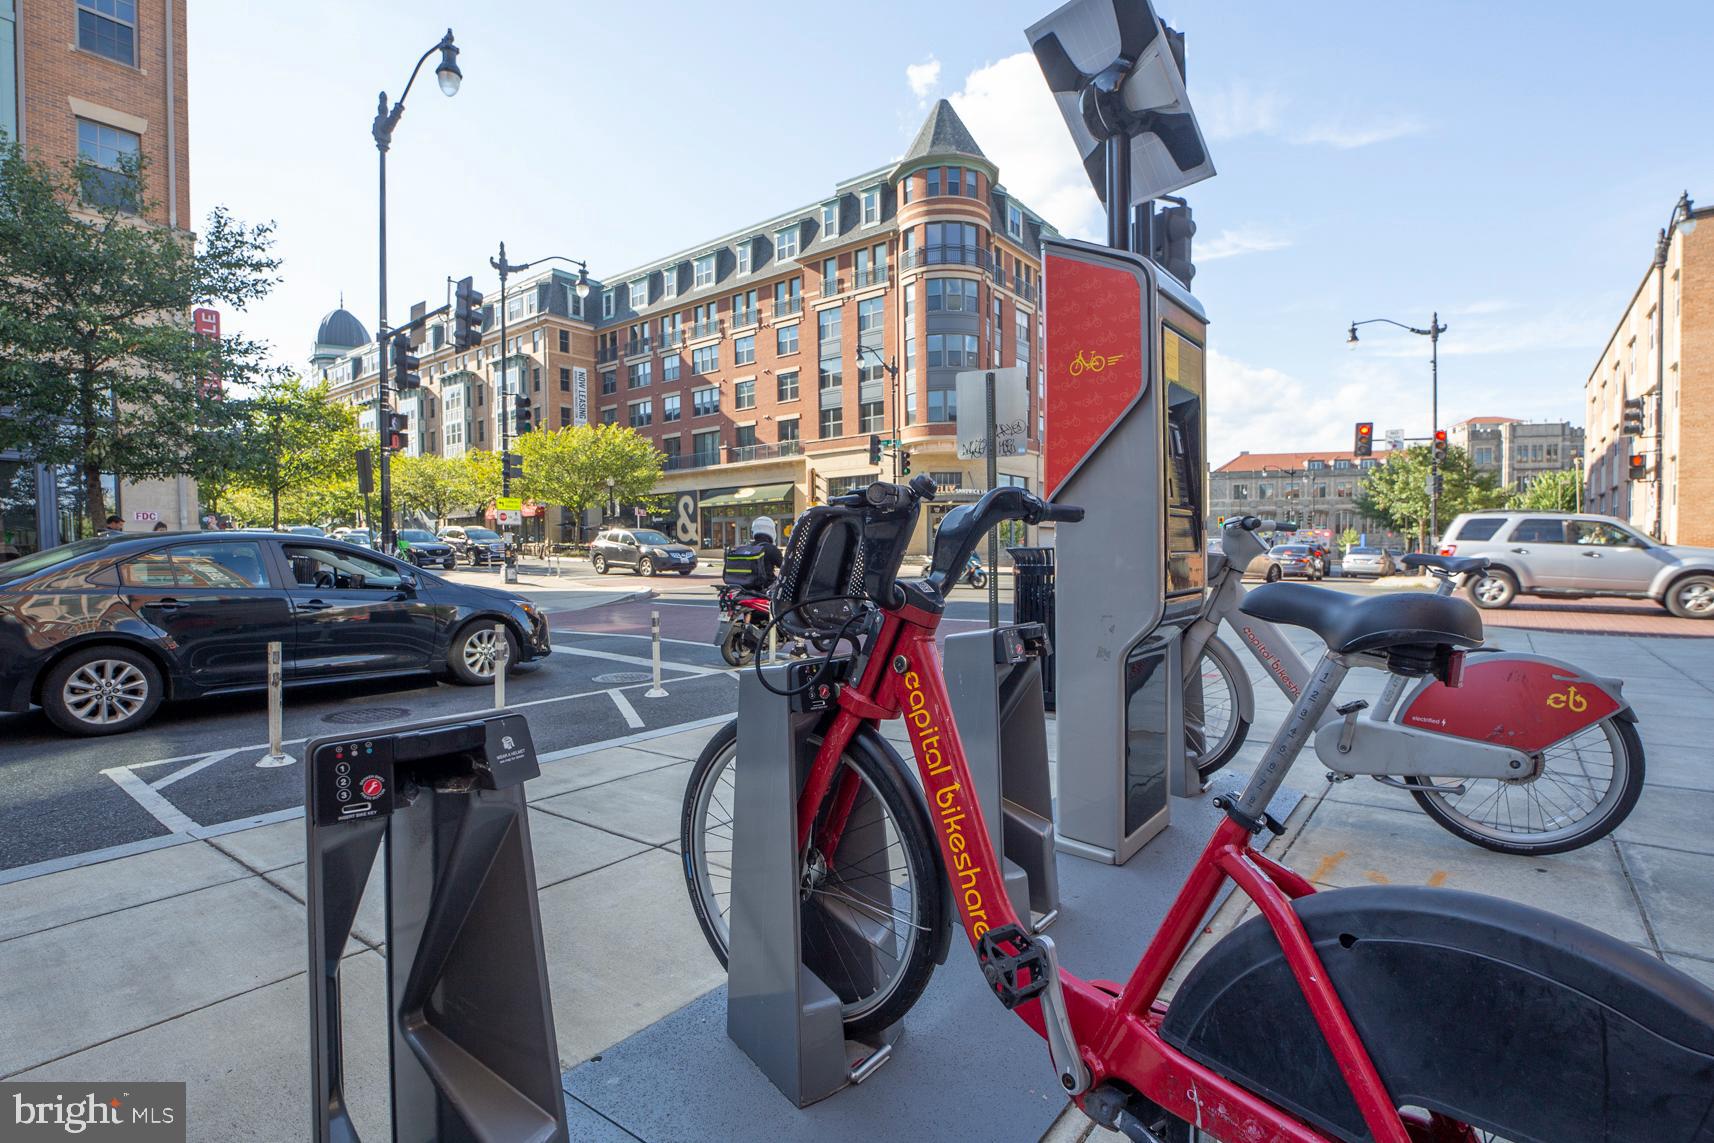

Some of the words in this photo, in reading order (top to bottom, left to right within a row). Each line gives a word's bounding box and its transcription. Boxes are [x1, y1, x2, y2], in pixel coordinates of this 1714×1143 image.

[578, 371, 586, 389] NOW
[578, 390, 587, 420] LEASING
[135, 512, 157, 520] FDC
[676, 494, 698, 542] &
[1271, 659, 1301, 699] bikesha
[1412, 715, 1440, 724] electrified
[904, 671, 952, 776] capital
[935, 781, 990, 941] bikeshare
